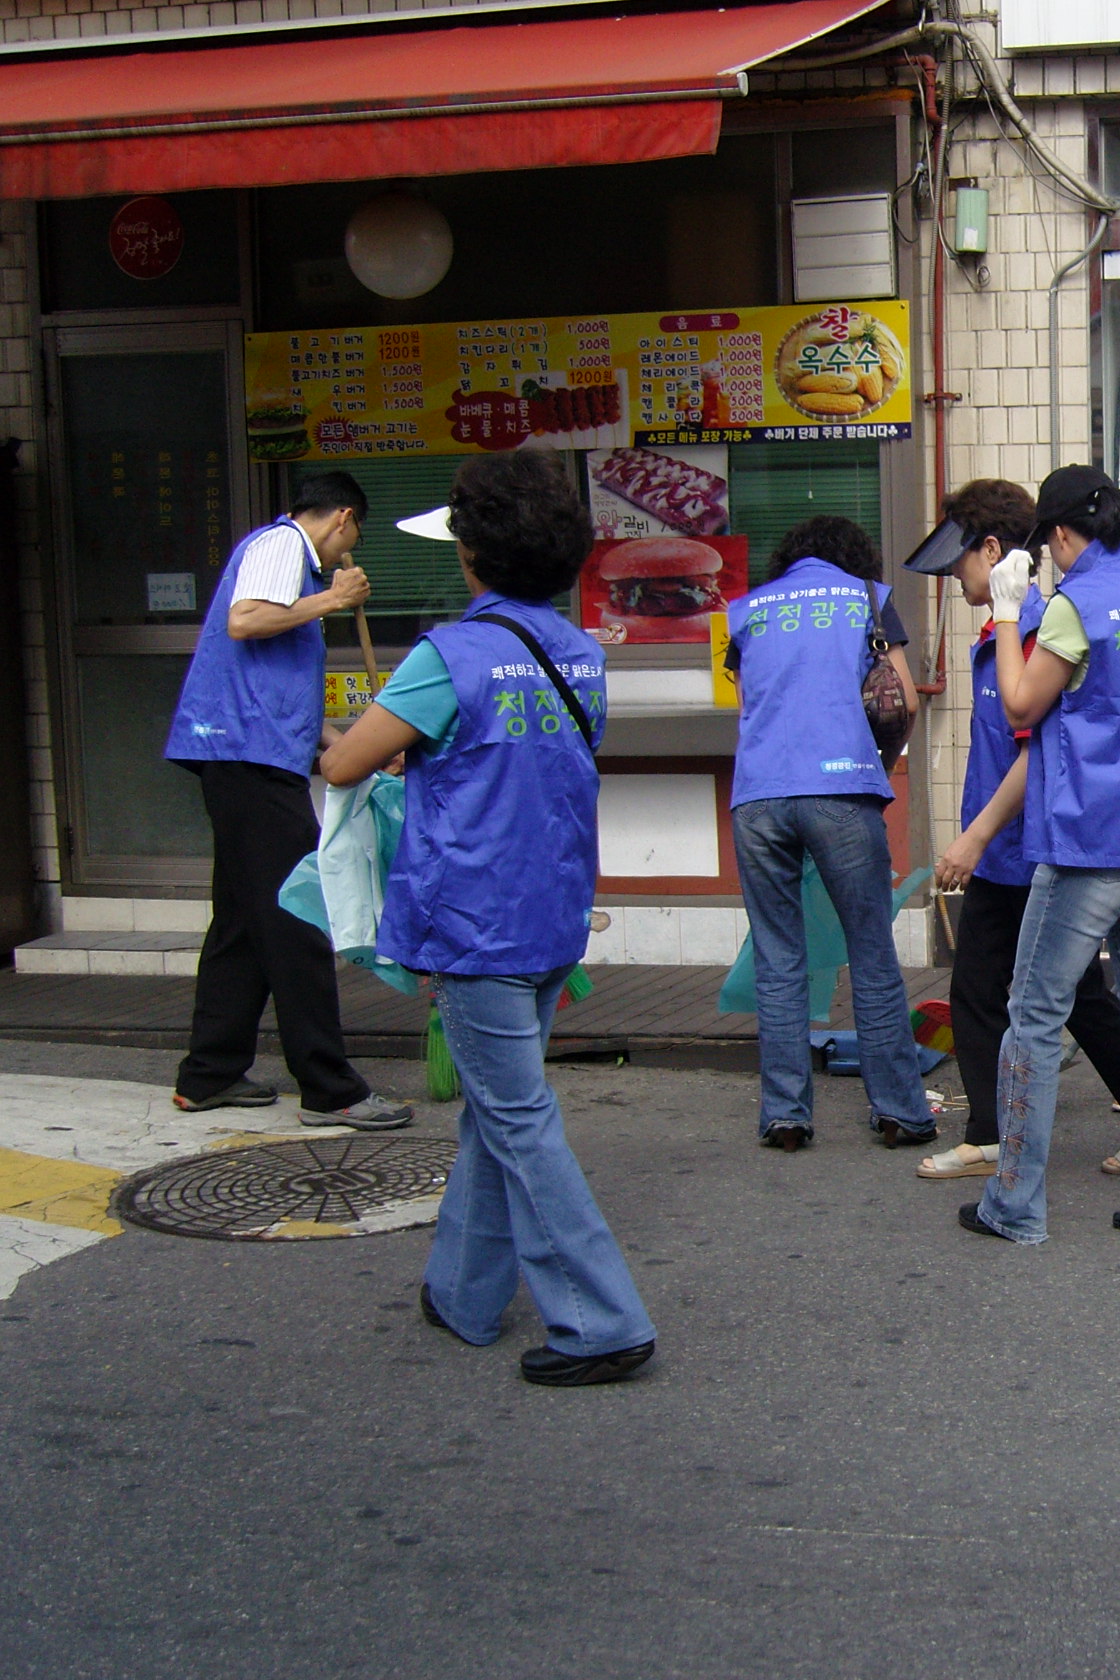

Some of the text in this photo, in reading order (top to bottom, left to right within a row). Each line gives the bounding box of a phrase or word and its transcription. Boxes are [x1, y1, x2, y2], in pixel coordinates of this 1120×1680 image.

[567, 321, 609, 334] 1,000원
[677, 315, 722, 330] 음료
[344, 335, 363, 345] 버거
[378, 331, 419, 345] 1200원
[579, 338, 611, 350] 500원
[640, 333, 762, 348] 아이스티 1,000원
[345, 352, 364, 361] 버거
[379, 346, 420, 360] 1200원
[641, 349, 762, 364] 레몬에이드 1,000원
[798, 344, 881, 375] 옥수수
[569, 355, 611, 367] 1,000원
[346, 369, 365, 377] 버거
[382, 364, 422, 376] 1,500원
[570, 371, 612, 384] 1200원
[641, 364, 762, 378] 체리에이드 1,000원
[346, 384, 366, 393] 버거
[383, 381, 423, 392] 1,500원
[720, 379, 762, 392] 1,000원
[347, 400, 366, 410] 버거
[384, 397, 424, 409] 1,500원
[731, 394, 763, 406] 500원
[459, 402, 493, 418] 바베큐
[731, 409, 763, 421] 500원
[322, 424, 343, 437] 모든
[386, 422, 418, 434] 고기는
[775, 428, 795, 440] 버거
[822, 427, 843, 439] 주문
[846, 425, 888, 438] 받습니다
[657, 430, 743, 444] 모든 메뉴 포장 가능
[623, 515, 649, 533] 갈비
[789, 588, 827, 600] 살기좋은
[830, 587, 869, 601] 맑은도시
[490, 663, 535, 680] 쾌적하고
